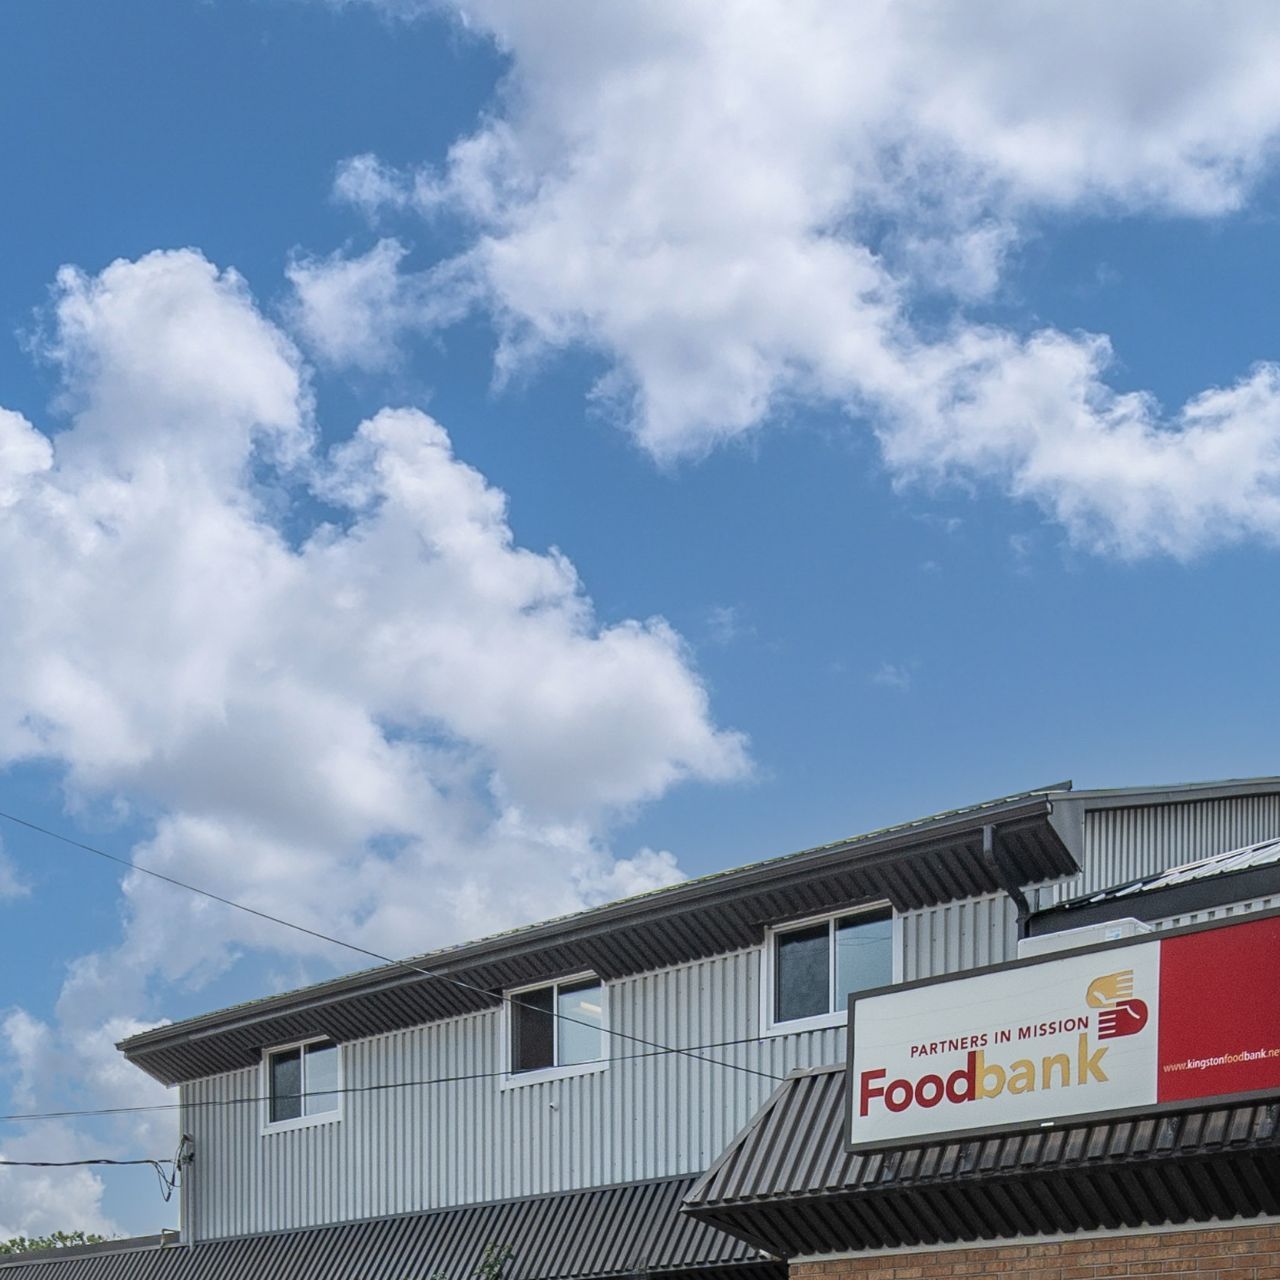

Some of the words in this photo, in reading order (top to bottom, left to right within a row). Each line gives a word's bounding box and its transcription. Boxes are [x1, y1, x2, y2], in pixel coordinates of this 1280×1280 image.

[911, 1034, 988, 1058] PARTNERS
[995, 1029, 1011, 1044] IN
[1018, 1016, 1089, 1040] MISSION
[859, 1032, 1109, 1117] Foodbank
